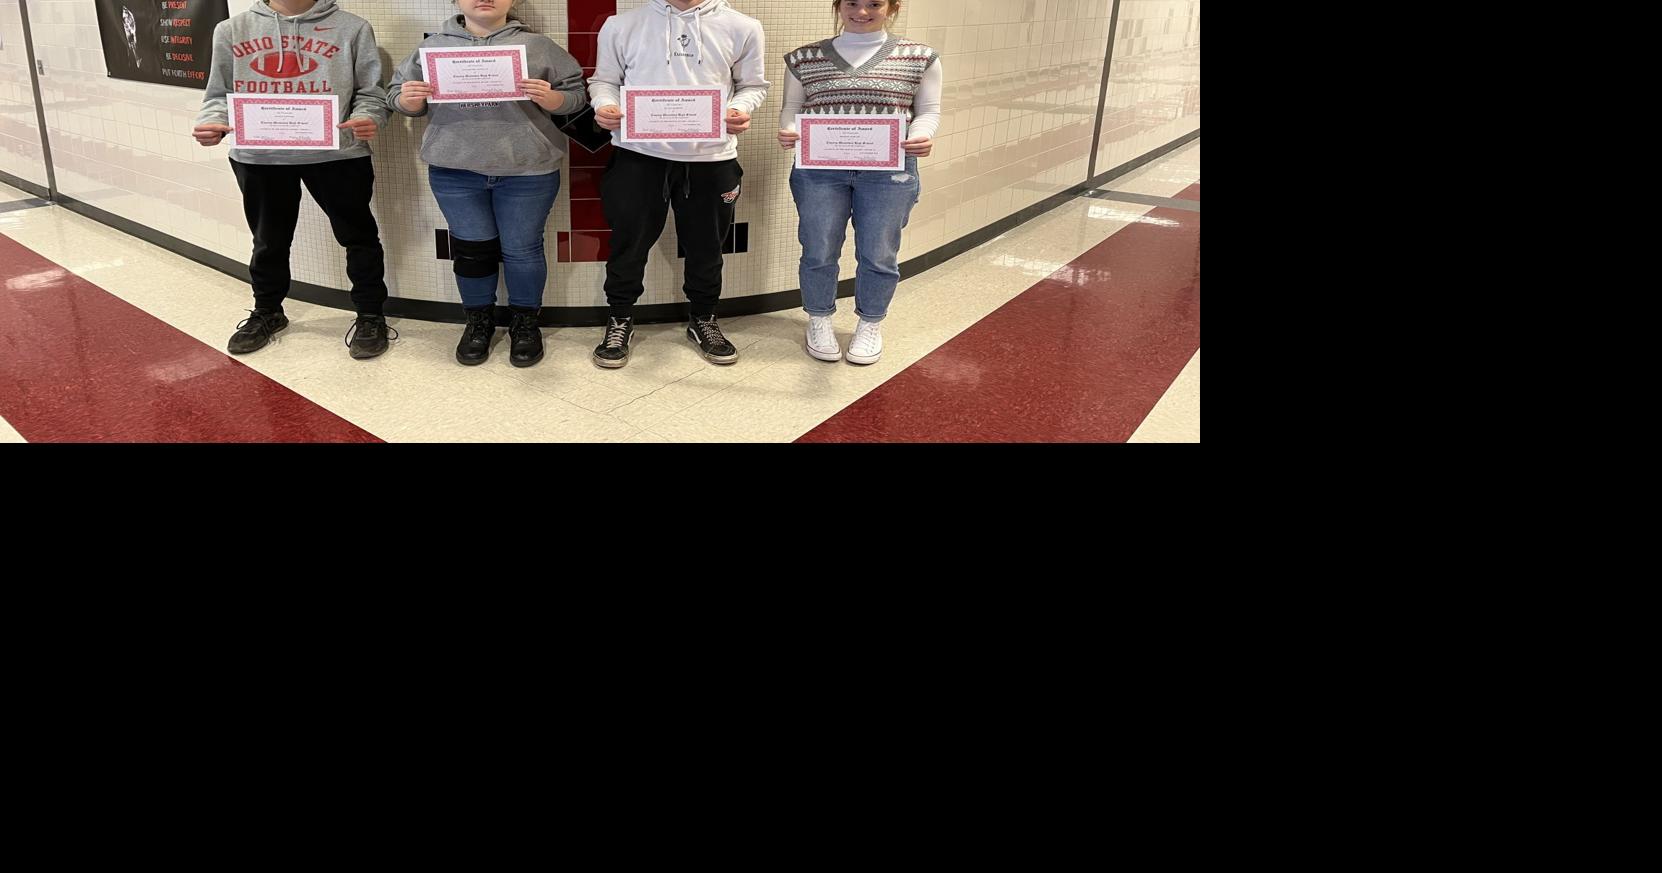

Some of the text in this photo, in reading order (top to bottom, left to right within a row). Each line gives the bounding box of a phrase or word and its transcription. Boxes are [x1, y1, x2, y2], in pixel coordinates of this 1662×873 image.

[168, 1, 187, 9] PRESENT
[160, 18, 192, 27] SHOW RESPECT
[170, 36, 192, 45] INTEGRITY
[232, 35, 340, 58] OHIO STATE
[234, 80, 332, 94] FOOTBALL
